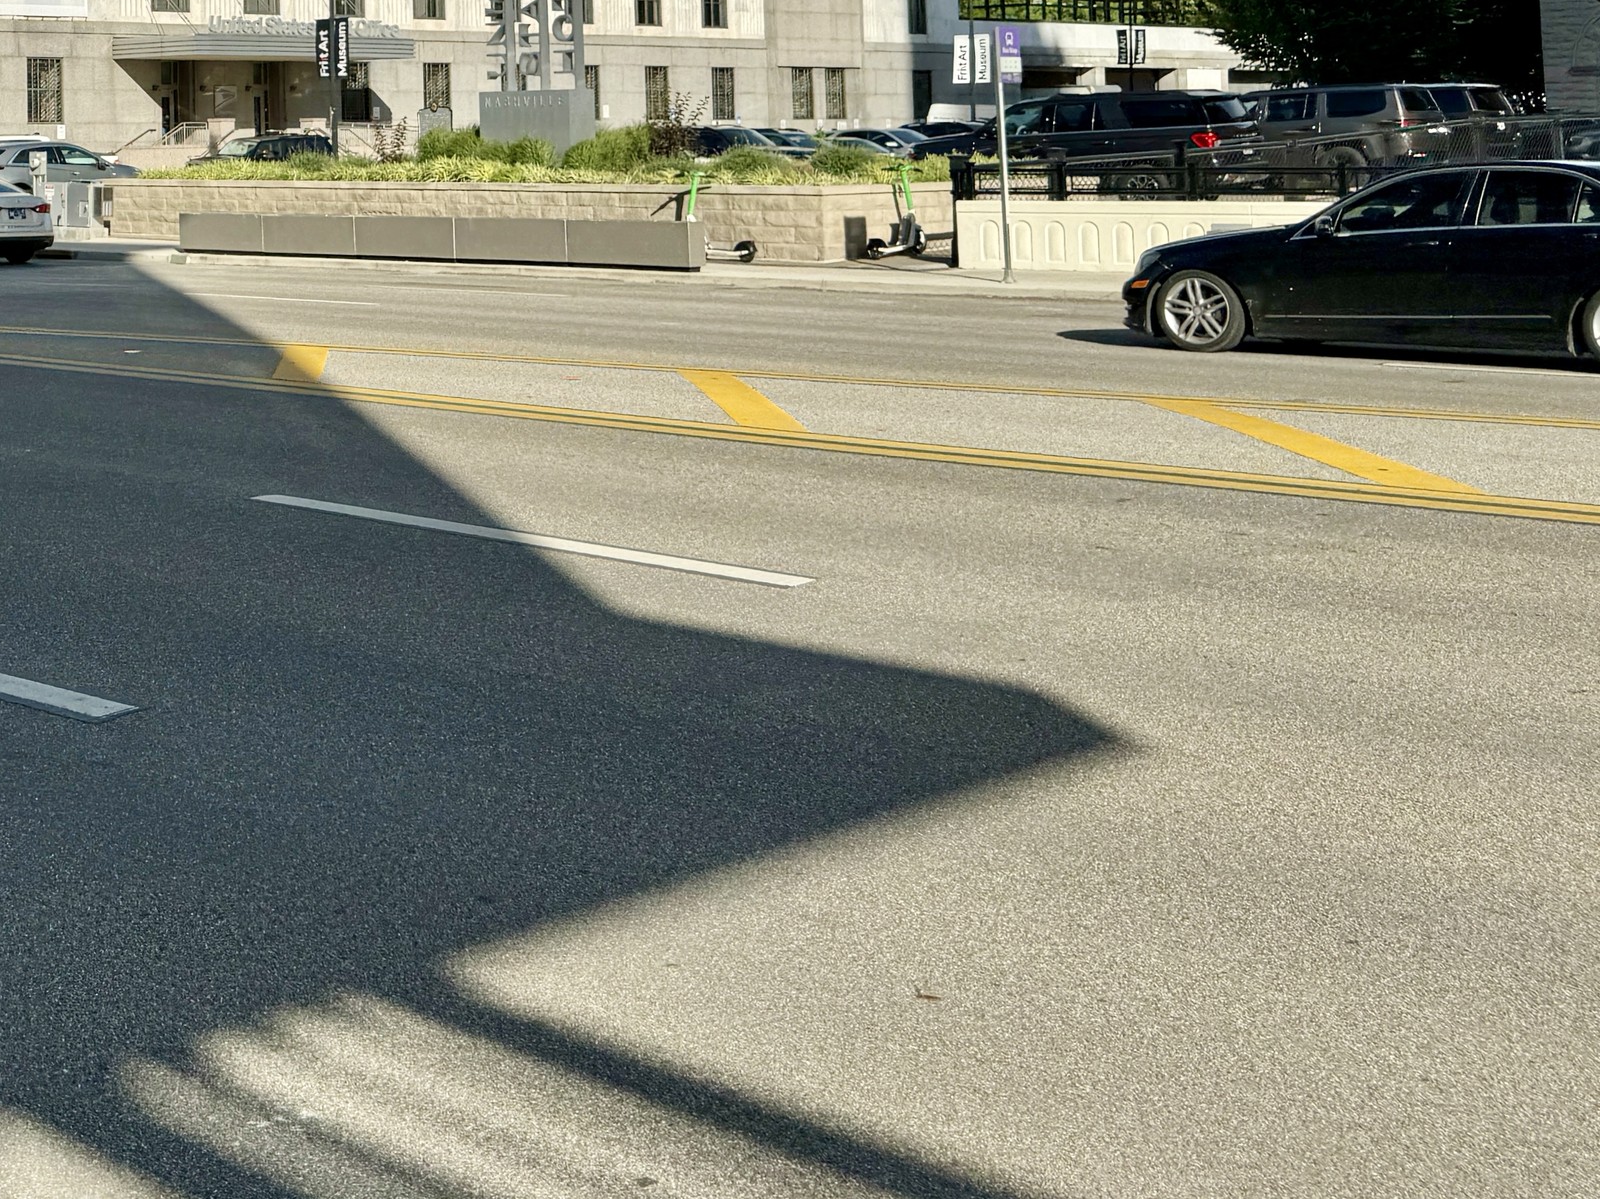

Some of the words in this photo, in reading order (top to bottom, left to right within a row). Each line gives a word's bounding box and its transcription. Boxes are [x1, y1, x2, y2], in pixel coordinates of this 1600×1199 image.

[208, 15, 263, 34] United
[265, 16, 315, 36] States
[353, 18, 401, 38] Office
[318, 30, 329, 52] Art
[337, 21, 348, 77] Museum
[958, 45, 967, 61] Art
[978, 38, 987, 80] Museum
